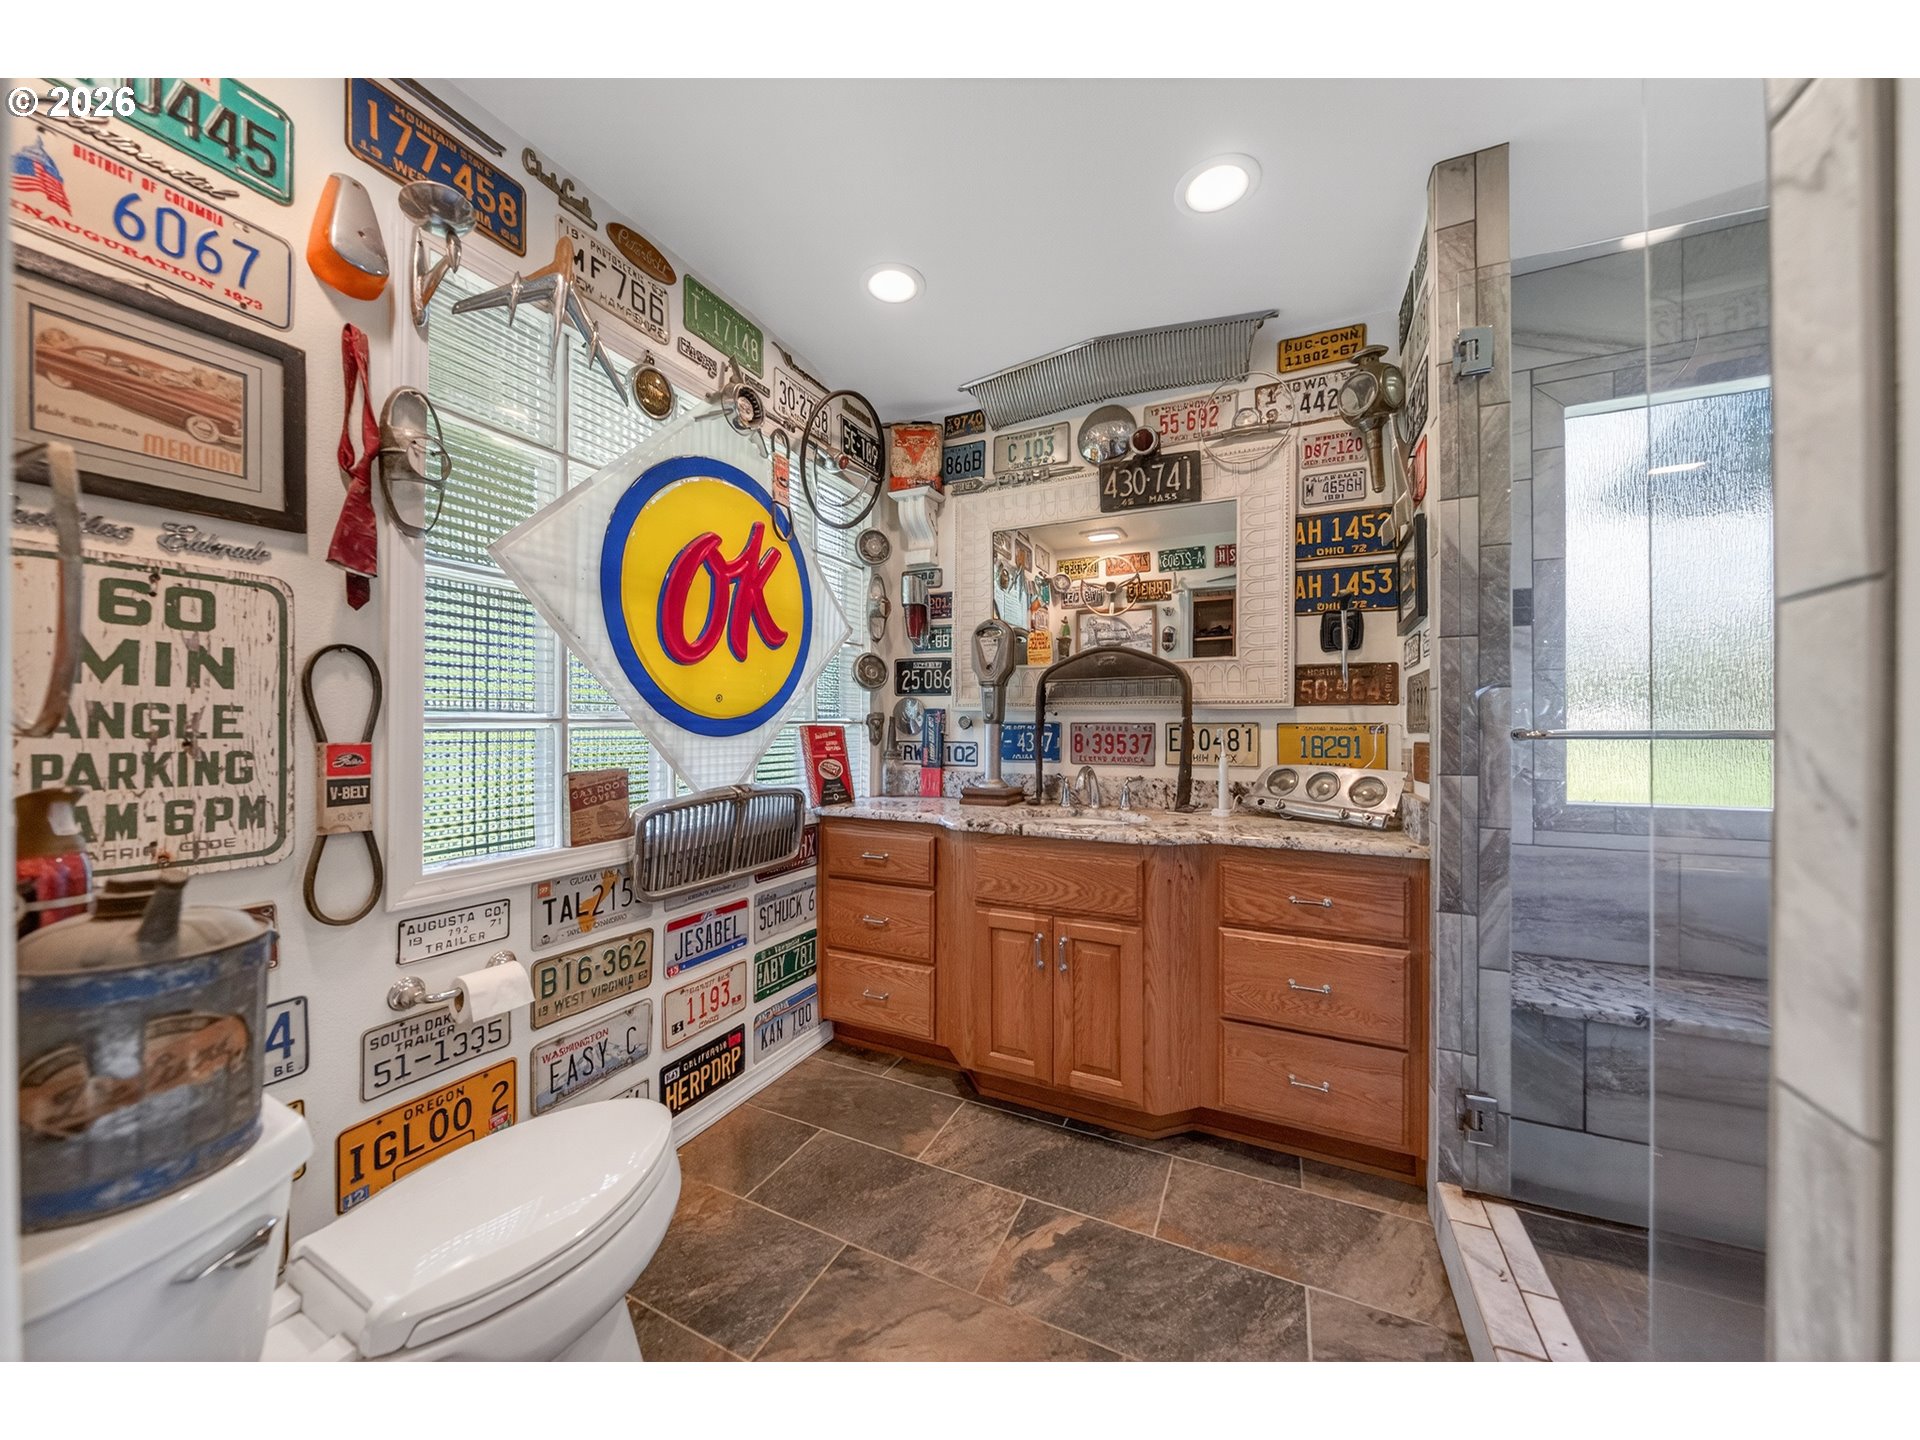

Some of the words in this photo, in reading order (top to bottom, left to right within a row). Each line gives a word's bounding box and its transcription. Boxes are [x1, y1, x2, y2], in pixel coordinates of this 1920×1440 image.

[395, 105, 457, 153] MOUNTAIN
[367, 99, 518, 229] 177-458
[73, 144, 134, 184] DISTRICT
[141, 178, 158, 195] OF
[165, 189, 223, 228] COLUMBIA
[11, 199, 215, 290] INAUGURATION
[224, 288, 263, 311] 1973
[114, 193, 260, 290] 6067
[575, 276, 594, 293] EW
[144, 433, 241, 474] MERCURY
[1149, 493, 1177, 504] MASS
[1296, 519, 1321, 545] AH
[657, 521, 789, 666] OK
[1296, 574, 1321, 599] AH
[1332, 568, 1393, 597] 1453
[98, 576, 216, 633] 60
[75, 638, 235, 690] MIN
[50, 701, 243, 740] ANGLE
[1301, 735, 1361, 759] 18291
[30, 750, 254, 791] PARKING
[330, 785, 368, 800] V-BELT
[73, 795, 266, 844] AM-6PM
[406, 912, 475, 936] AUGUSTA
[485, 906, 504, 917] CO.
[543, 892, 589, 925] TAL
[592, 877, 642, 916] 215
[759, 896, 803, 931] SCHUCK
[409, 936, 423, 947] 19
[426, 931, 486, 954] TRAILER
[674, 915, 741, 962] JESABEL
[541, 940, 647, 1000] B16-362
[555, 991, 585, 1013] WEST
[591, 974, 634, 998] VIRGINIA
[687, 980, 730, 1025] 1193
[265, 1011, 295, 1059] 4
[370, 1024, 419, 1051] SOUTH
[425, 1013, 456, 1031] DAK
[396, 1025, 455, 1053] TRAILER
[542, 1028, 609, 1063] WASHINGTON
[761, 1018, 783, 1050] KAN
[374, 1018, 502, 1089] 51-1335
[550, 1038, 608, 1094] EASY
[626, 1026, 637, 1054] C
[666, 1046, 741, 1110] HERPDRP
[404, 1085, 465, 1121] OREGON
[350, 1097, 472, 1184] IGLOO
[491, 1080, 509, 1115] 2
